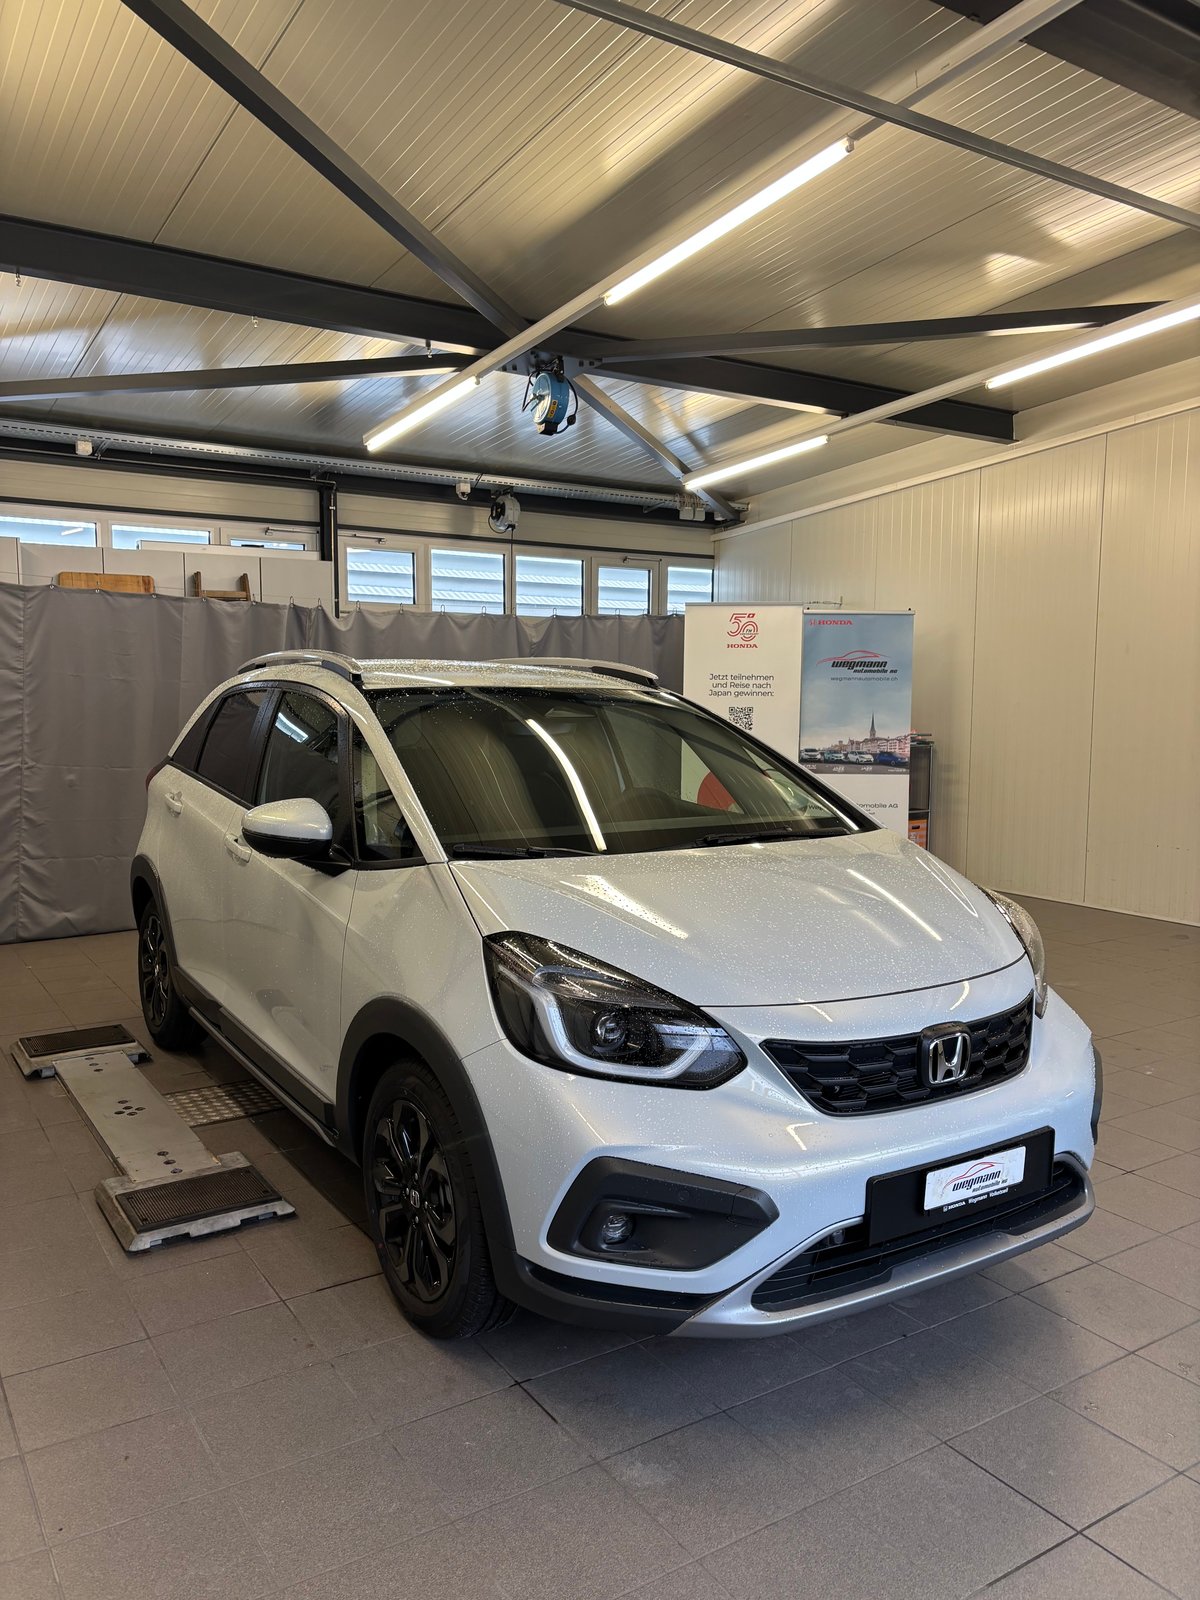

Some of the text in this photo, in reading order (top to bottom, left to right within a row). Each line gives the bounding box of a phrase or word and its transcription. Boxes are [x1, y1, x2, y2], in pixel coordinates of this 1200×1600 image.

[831, 660, 888, 670] wegmann
[709, 673, 775, 681] Jetzt teilnehmen
[712, 681, 772, 689] und Reise nach
[708, 689, 775, 698] Japan gewinnen:
[952, 1170, 1002, 1191] wegmann
[948, 1201, 967, 1210] HONDA
[968, 1194, 988, 1204] Wegmann
